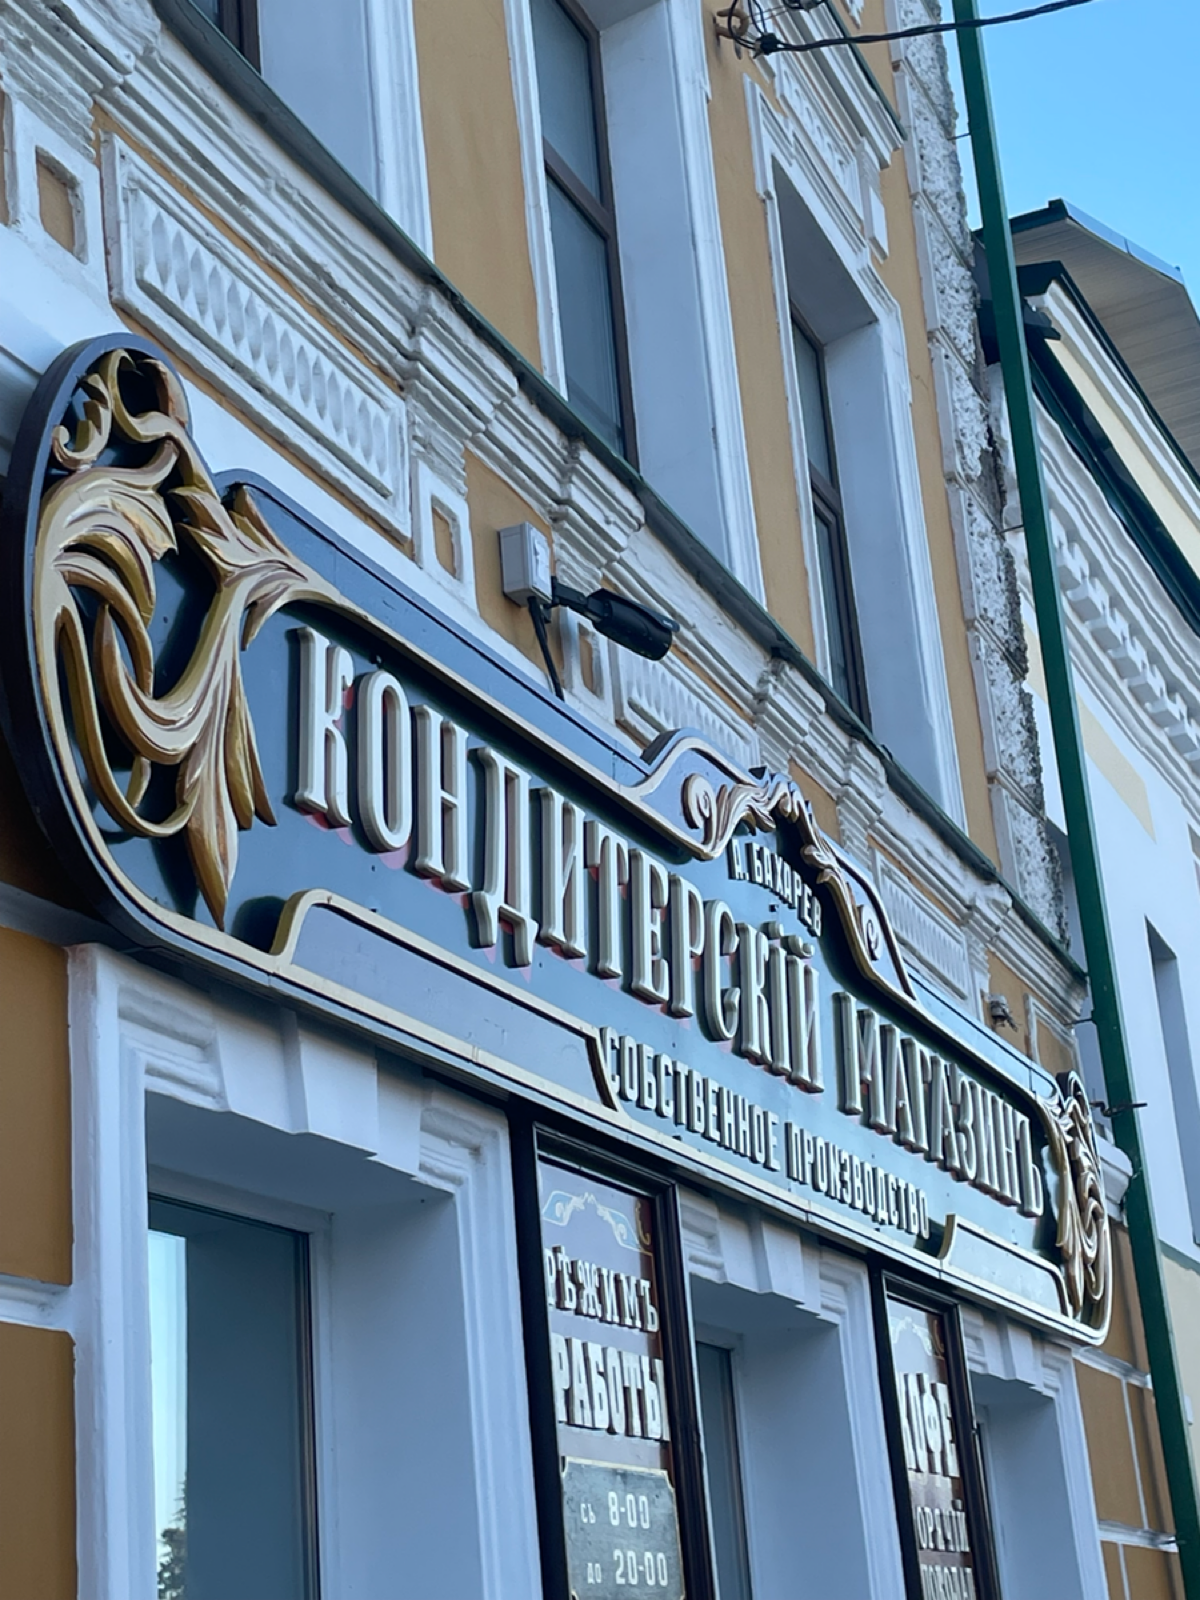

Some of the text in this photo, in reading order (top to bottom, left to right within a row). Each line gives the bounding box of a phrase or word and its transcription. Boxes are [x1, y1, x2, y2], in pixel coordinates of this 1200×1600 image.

[728, 838, 822, 937] А. БАХАРЕВ
[600, 1026, 930, 1240] СОБСТВЕННОЕ ПРОИЗВОДСТВО
[833, 991, 1044, 1218] МАГАЗИНЪ
[550, 1332, 670, 1442] РАБОТЫ
[608, 1491, 650, 1529] 8-00
[613, 1549, 668, 1587] 20-00
